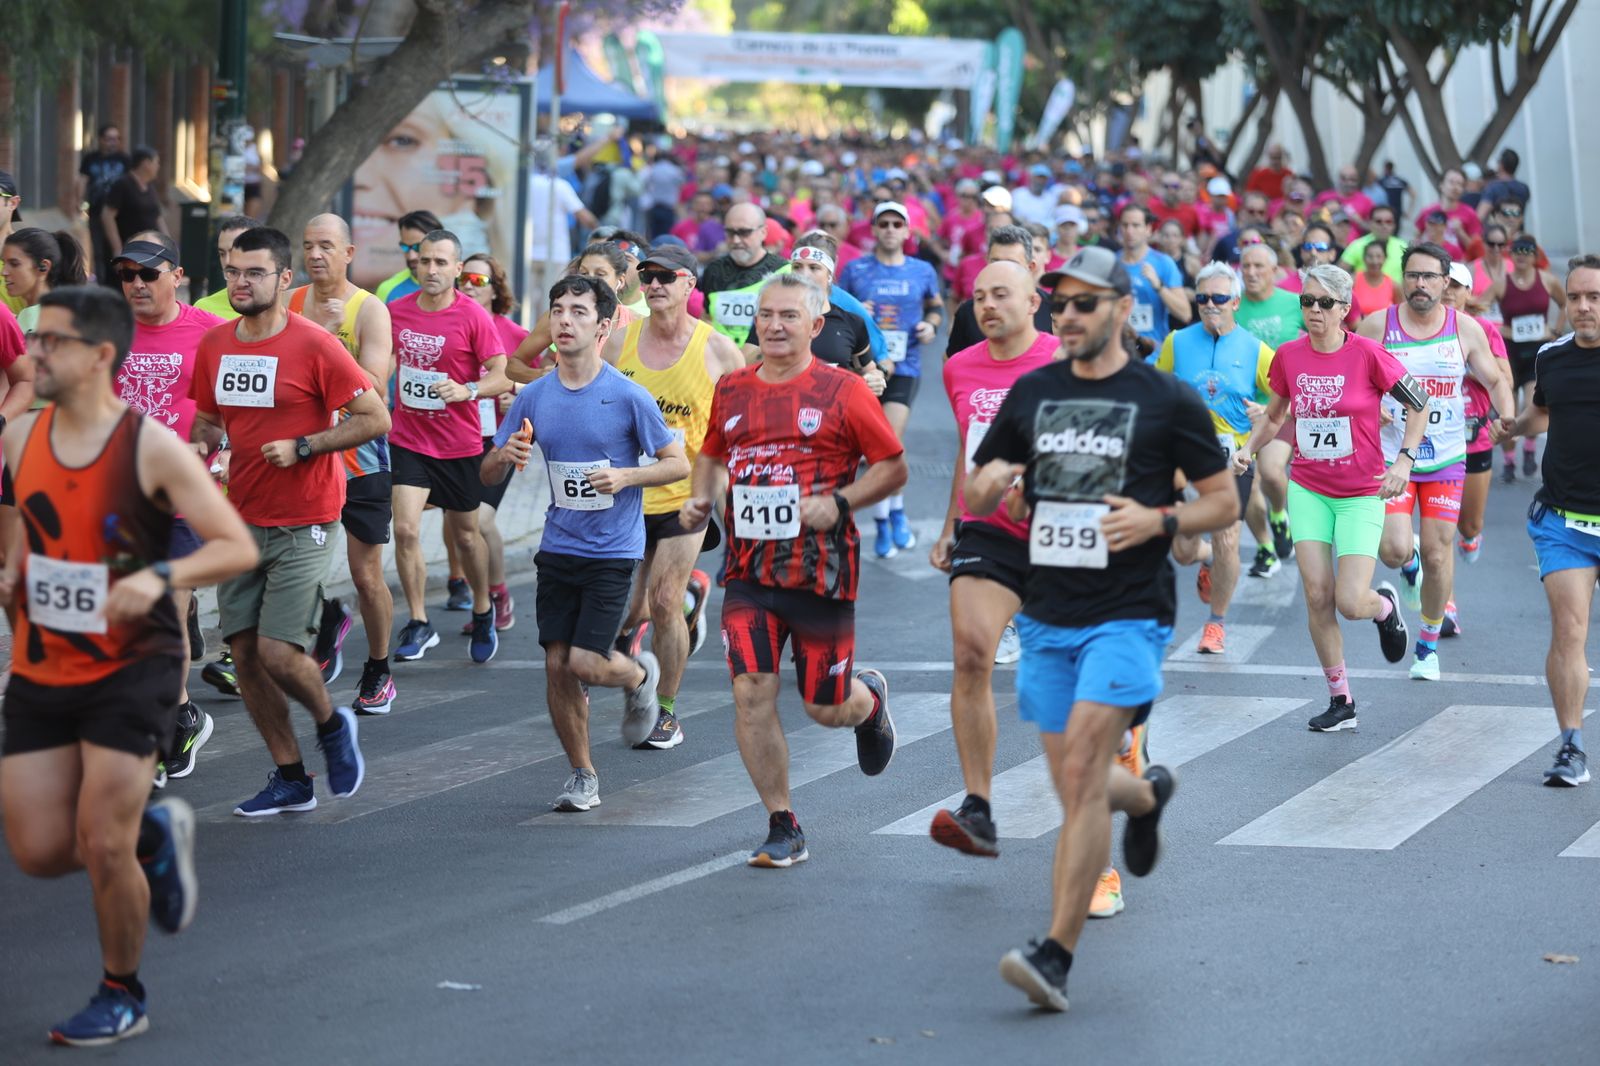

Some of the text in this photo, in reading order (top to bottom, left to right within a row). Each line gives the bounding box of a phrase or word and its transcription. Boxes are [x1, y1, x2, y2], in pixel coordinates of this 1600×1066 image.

[721, 303, 754, 317] 700
[222, 372, 268, 393] 690
[1400, 408, 1441, 425] 50
[1036, 428, 1124, 458] adidas
[1309, 433, 1338, 449] 74
[564, 479, 597, 498] 62
[741, 505, 793, 525] 410
[1038, 525, 1096, 549] 359
[35, 580, 96, 612] 536
